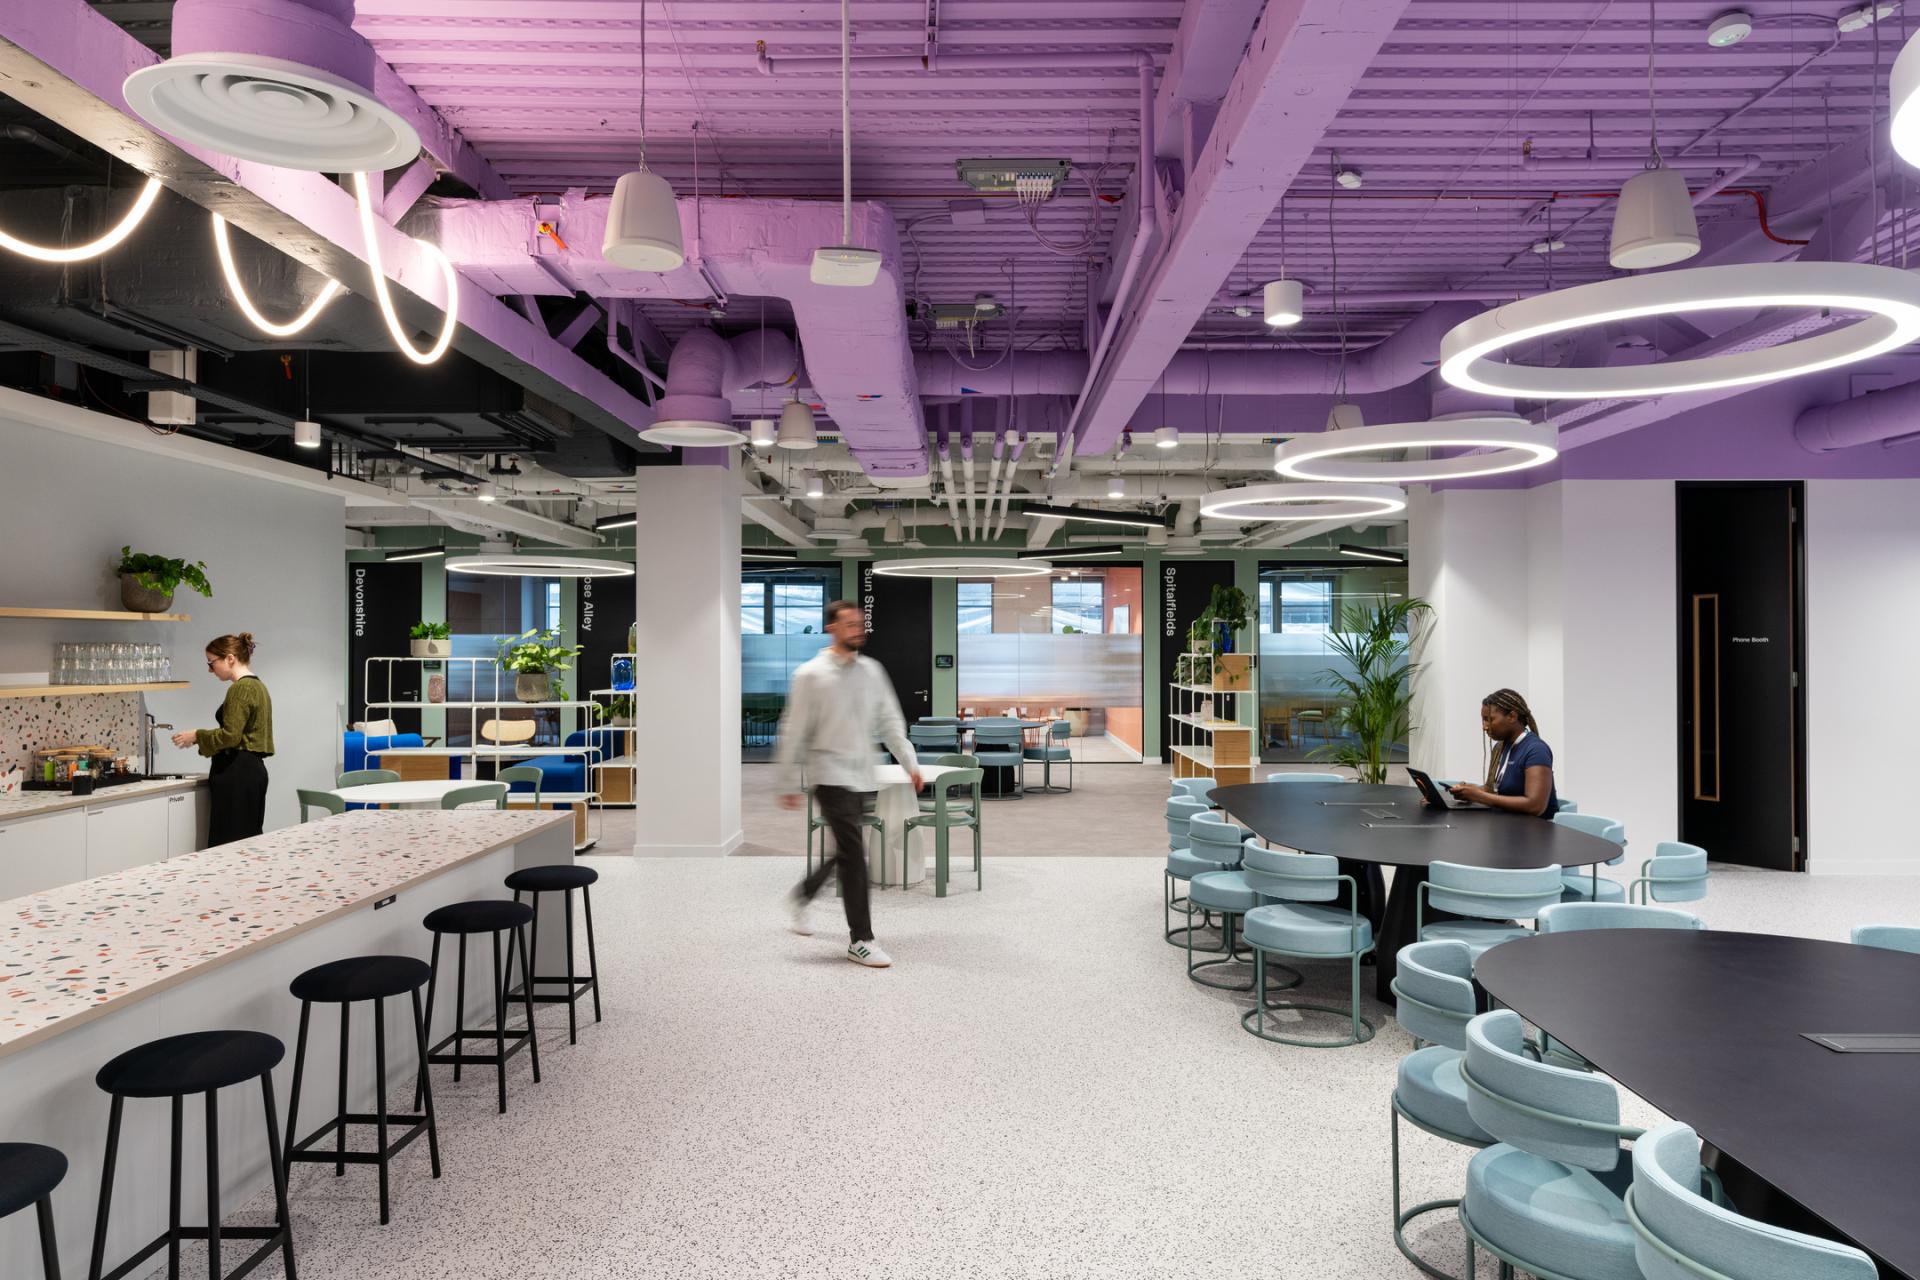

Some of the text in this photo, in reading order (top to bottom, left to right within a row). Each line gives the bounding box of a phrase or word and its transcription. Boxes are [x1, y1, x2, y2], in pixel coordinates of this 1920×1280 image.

[355, 568, 366, 637] Devonshire
[582, 574, 594, 631] ose Alley
[864, 568, 875, 634] Sun Street
[1164, 567, 1176, 637] Spitalfields
